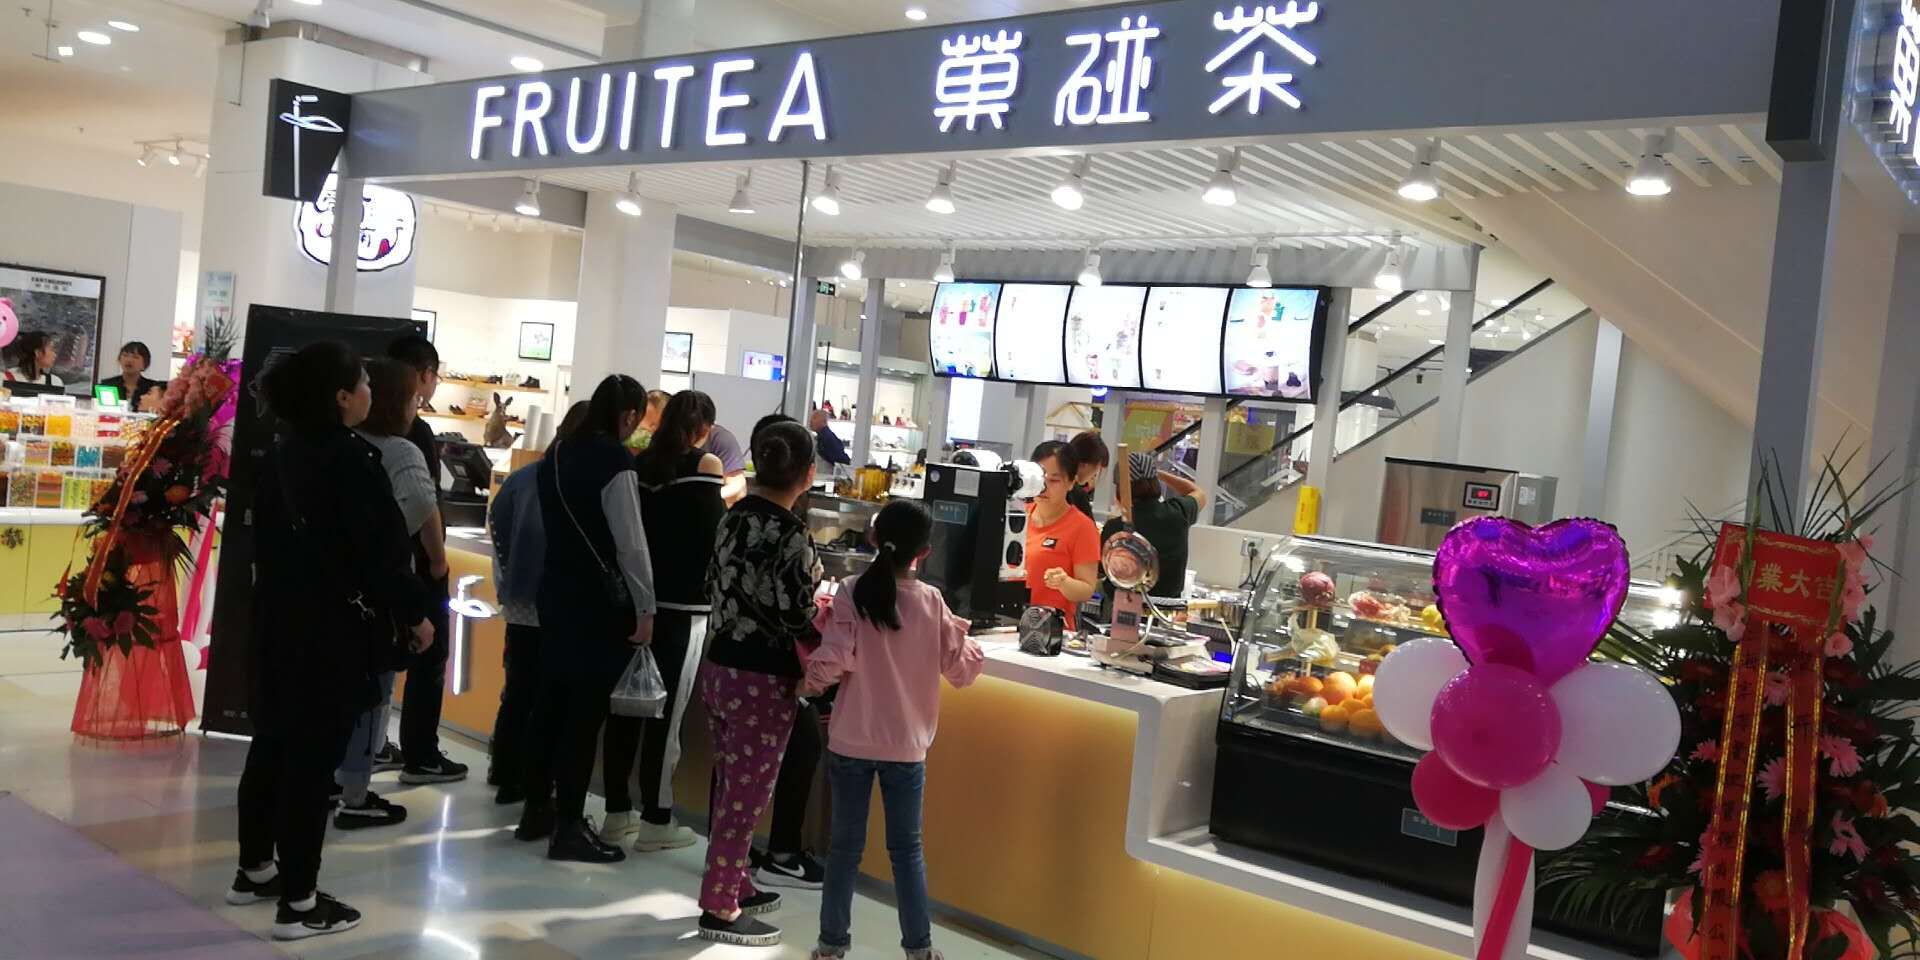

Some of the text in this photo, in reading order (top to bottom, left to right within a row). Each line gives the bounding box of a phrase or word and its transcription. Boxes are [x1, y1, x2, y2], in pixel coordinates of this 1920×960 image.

[470, 52, 827, 160] FRUITEA
[933, 0, 1319, 133] 菓碰茶
[1746, 559, 1838, 602] 業大吉
